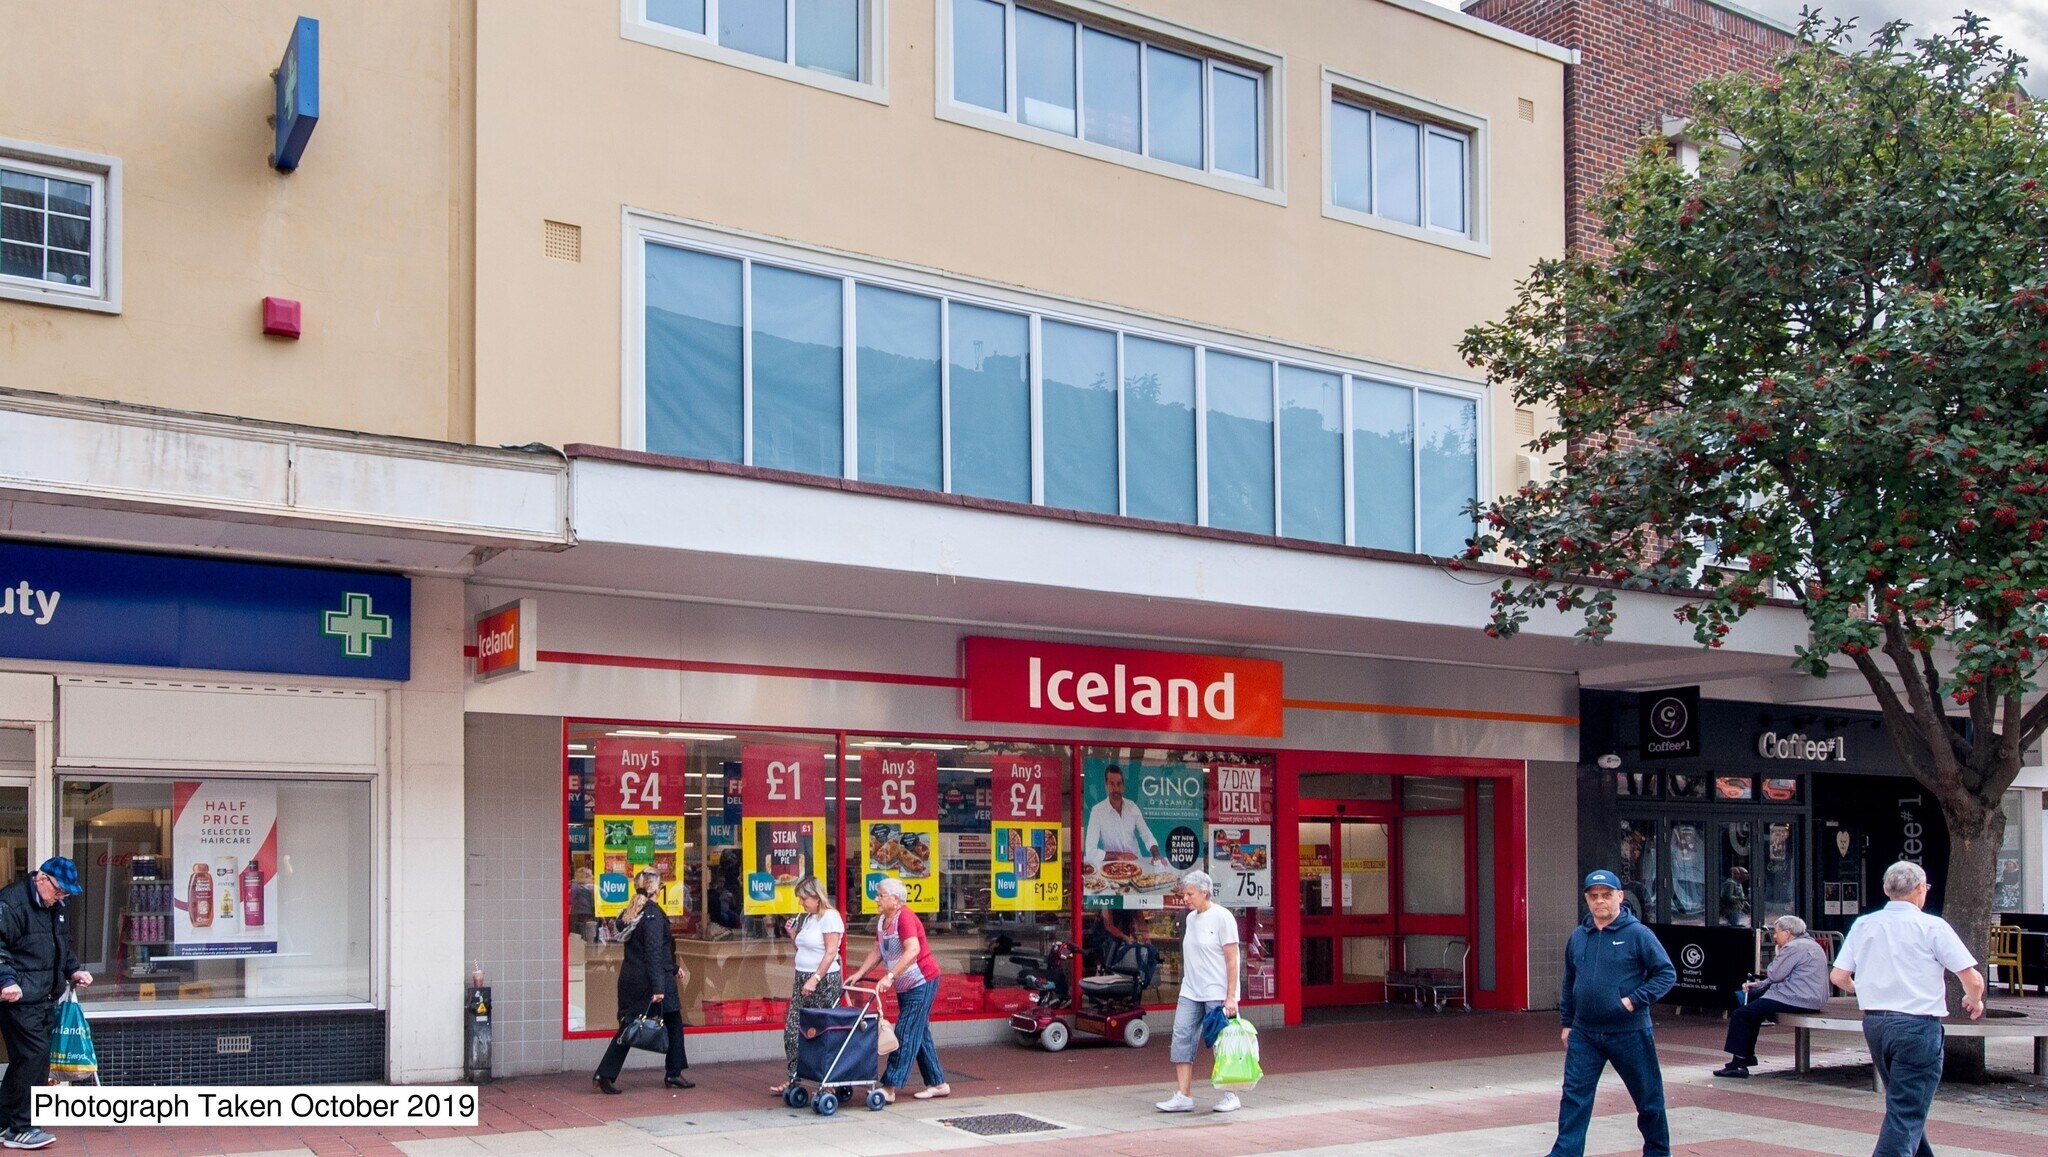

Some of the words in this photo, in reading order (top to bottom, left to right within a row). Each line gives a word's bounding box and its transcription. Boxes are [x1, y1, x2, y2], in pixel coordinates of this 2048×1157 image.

[0, 580, 61, 625] uty
[479, 623, 515, 659] Iceland
[1028, 656, 1235, 721] Iceland
[621, 749, 648, 771] Any
[651, 750, 660, 767] 5
[881, 759, 904, 779] Any
[906, 760, 915, 775] 3
[766, 761, 801, 801] £1
[1011, 763, 1032, 782] Any
[1034, 764, 1042, 779] 3
[1222, 769, 1230, 789] 7
[1231, 770, 1256, 790] DAY
[619, 771, 662, 810] £4
[1141, 775, 1200, 798] GINO
[205, 801, 247, 811] HALF
[881, 779, 917, 815] £5
[1010, 782, 1044, 817] £4
[1222, 791, 1258, 813] DEAL
[203, 814, 249, 825] PRICE
[801, 824, 811, 833] £1
[201, 828, 251, 836] SELECTED
[568, 834, 586, 843] NEW
[710, 824, 731, 836] NEW
[772, 830, 798, 844] STEAK
[773, 848, 797, 857] PROPER
[780, 856, 790, 865] PIE
[1171, 854, 1194, 862] NOW
[603, 880, 626, 893] New
[751, 880, 773, 892] New
[868, 880, 878, 892] Ne
[997, 878, 1016, 890] New
[1034, 882, 1058, 901] £1.59
[1236, 872, 1264, 900] 75p
[660, 884, 667, 905] 1
[1092, 898, 1115, 906] MADE
